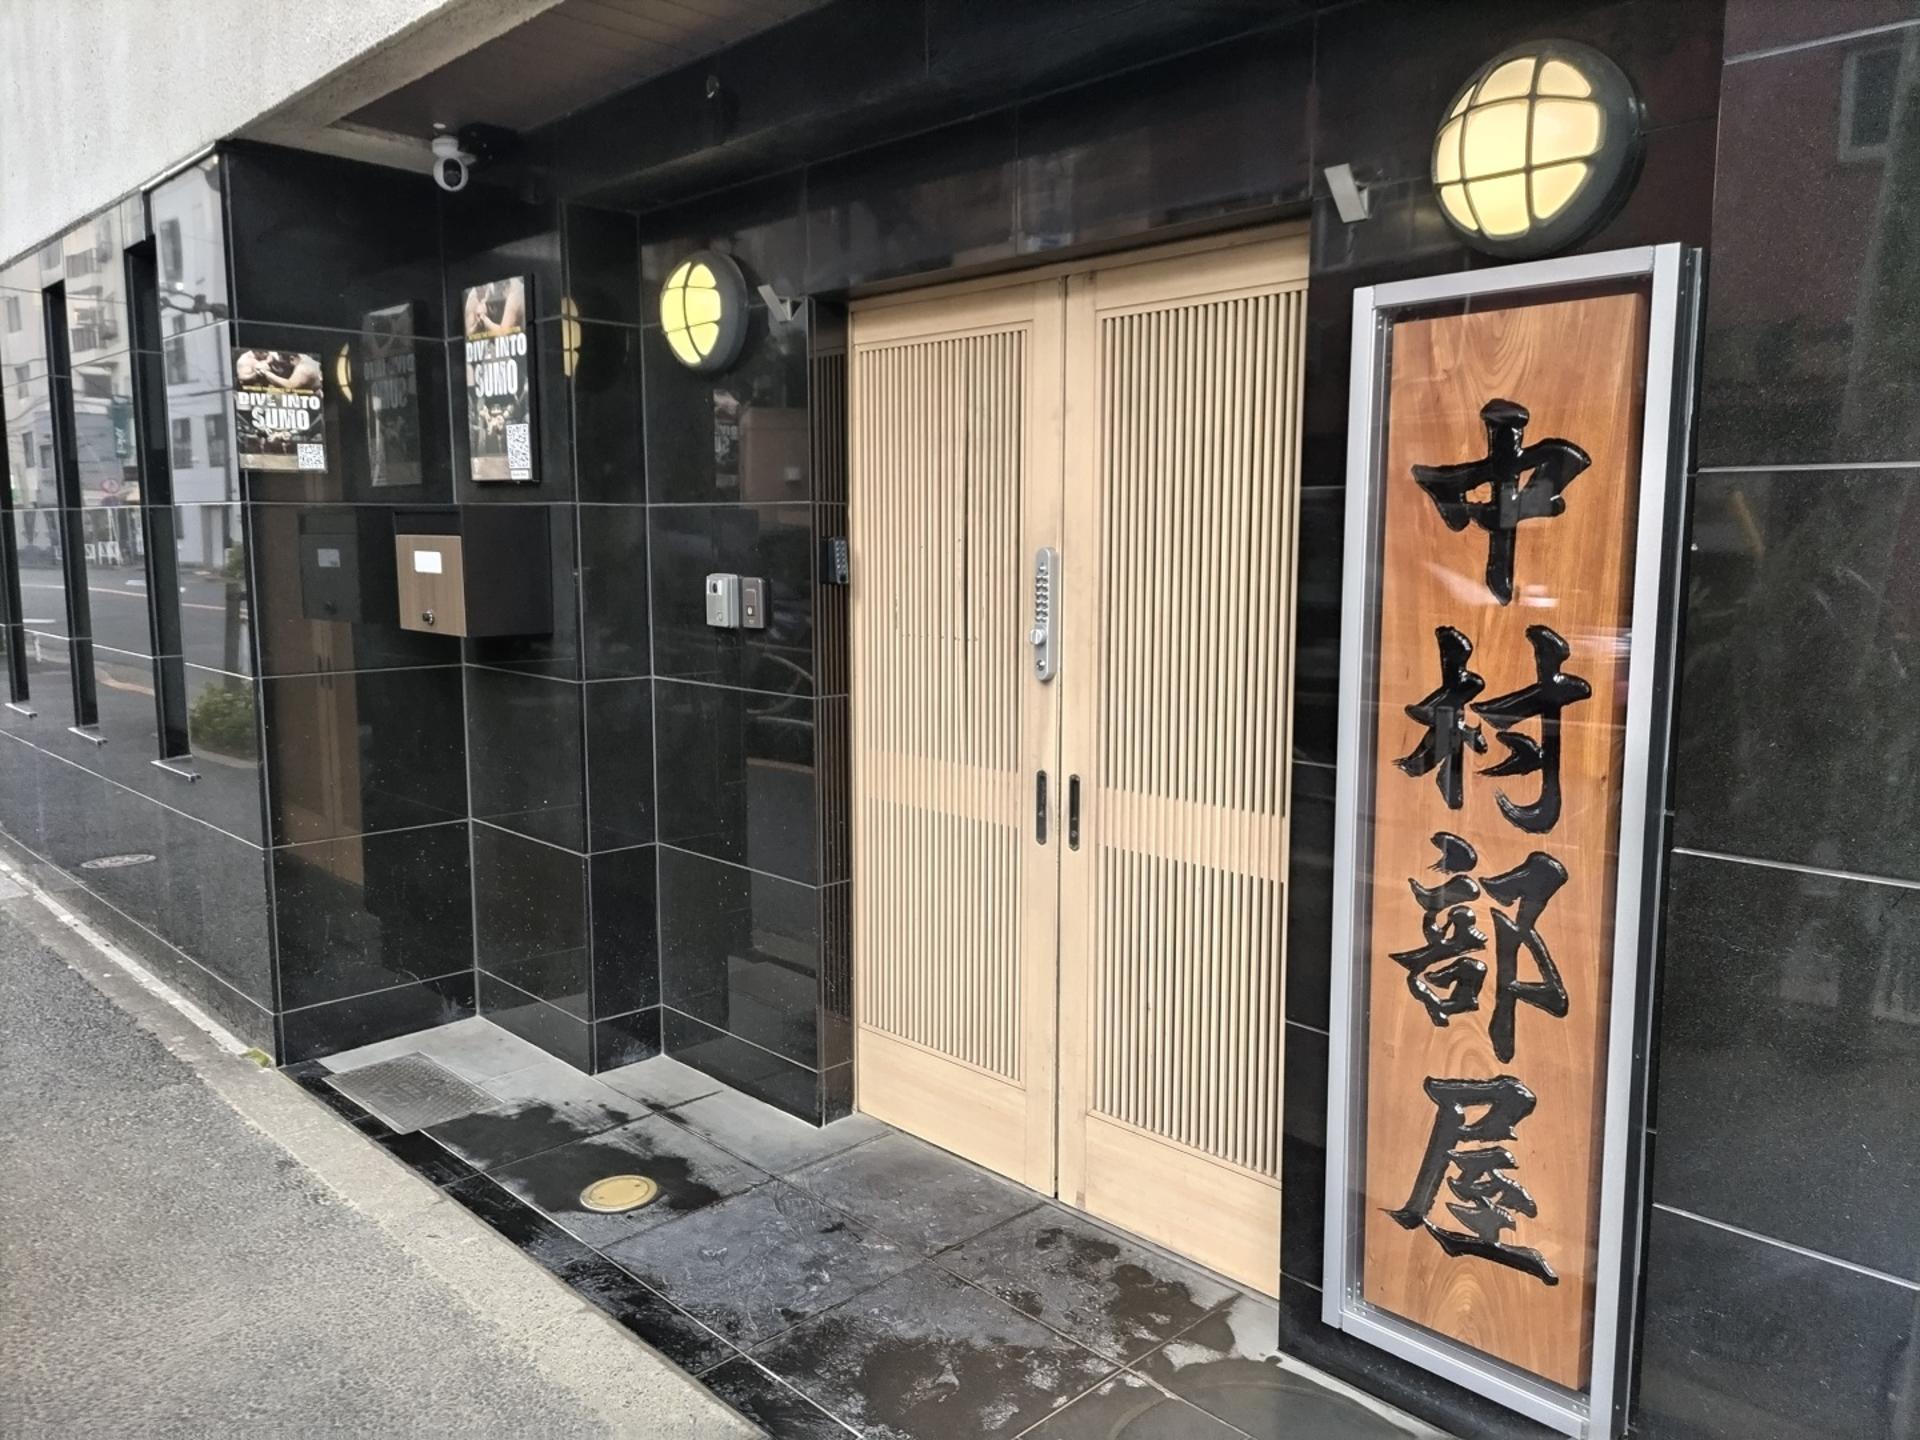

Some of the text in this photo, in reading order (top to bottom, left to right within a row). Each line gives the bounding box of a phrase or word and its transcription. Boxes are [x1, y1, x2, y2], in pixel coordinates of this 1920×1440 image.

[495, 332, 527, 358] INTO
[475, 359, 518, 398] SUMO
[281, 394, 320, 410] INTO
[251, 406, 310, 431] SUMO
[1377, 398, 1592, 1286] 中村部屋
